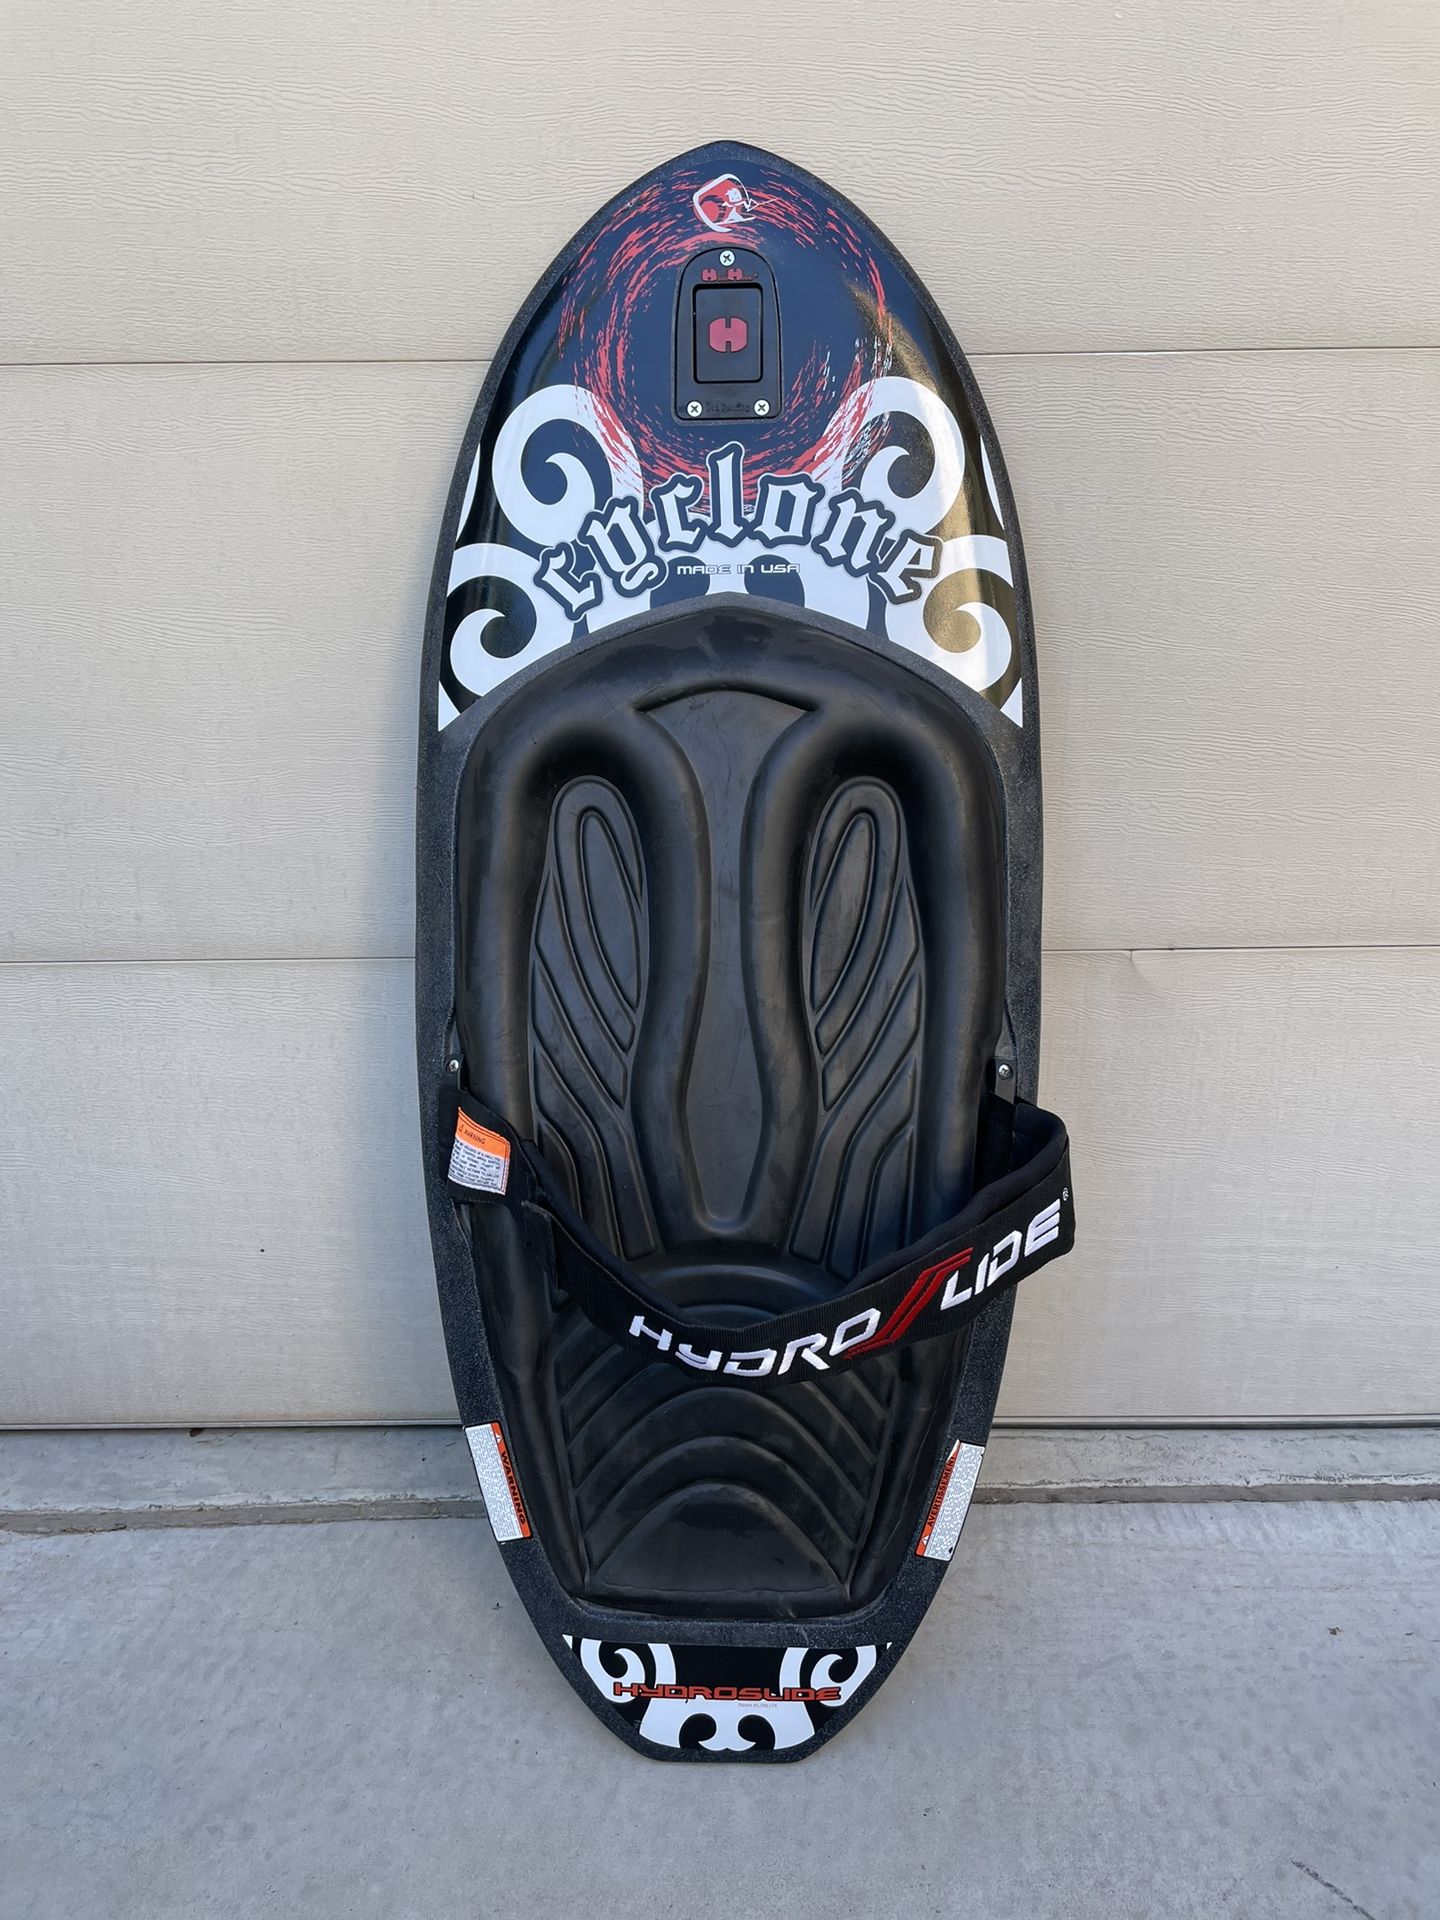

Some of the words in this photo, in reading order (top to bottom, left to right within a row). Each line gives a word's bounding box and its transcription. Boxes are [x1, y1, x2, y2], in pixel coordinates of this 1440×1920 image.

[676, 564, 731, 575] MADE
[737, 564, 755, 575] IN
[760, 563, 800, 574] USA
[501, 1450, 526, 1525] WARNING
[613, 1682, 842, 1702] HYDROSLIDE
